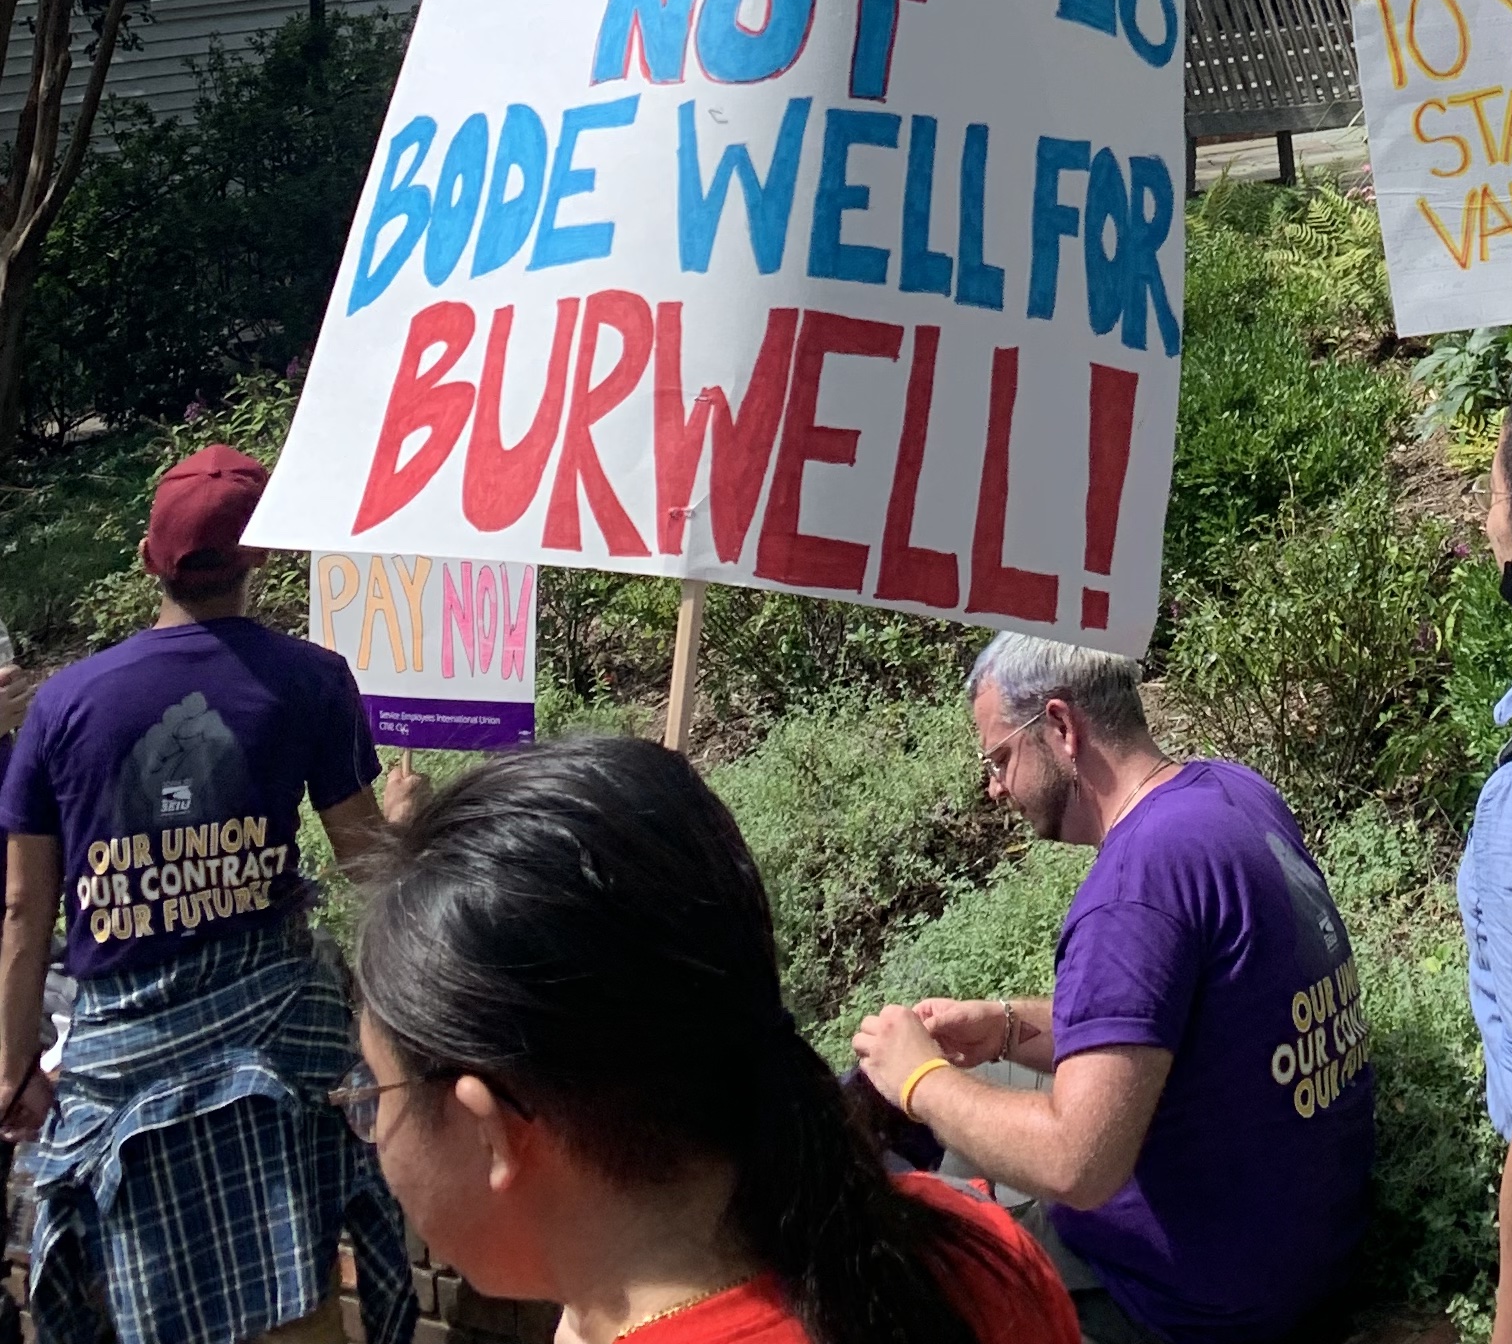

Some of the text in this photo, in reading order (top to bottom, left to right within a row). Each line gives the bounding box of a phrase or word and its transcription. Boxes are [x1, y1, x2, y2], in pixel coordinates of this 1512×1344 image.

[346, 93, 1181, 357] BODE WELL FOR
[352, 288, 1138, 631] BURWELL!
[318, 553, 534, 682] PAY NOW
[479, 716, 501, 725] Union
[88, 816, 267, 875] OUR UNION
[77, 844, 288, 910] OUR CONTRACT
[90, 904, 154, 944] OUR
[1292, 976, 1337, 1033] OUR
[1271, 1026, 1330, 1085] OUR
[1294, 1059, 1340, 1118] OUR
